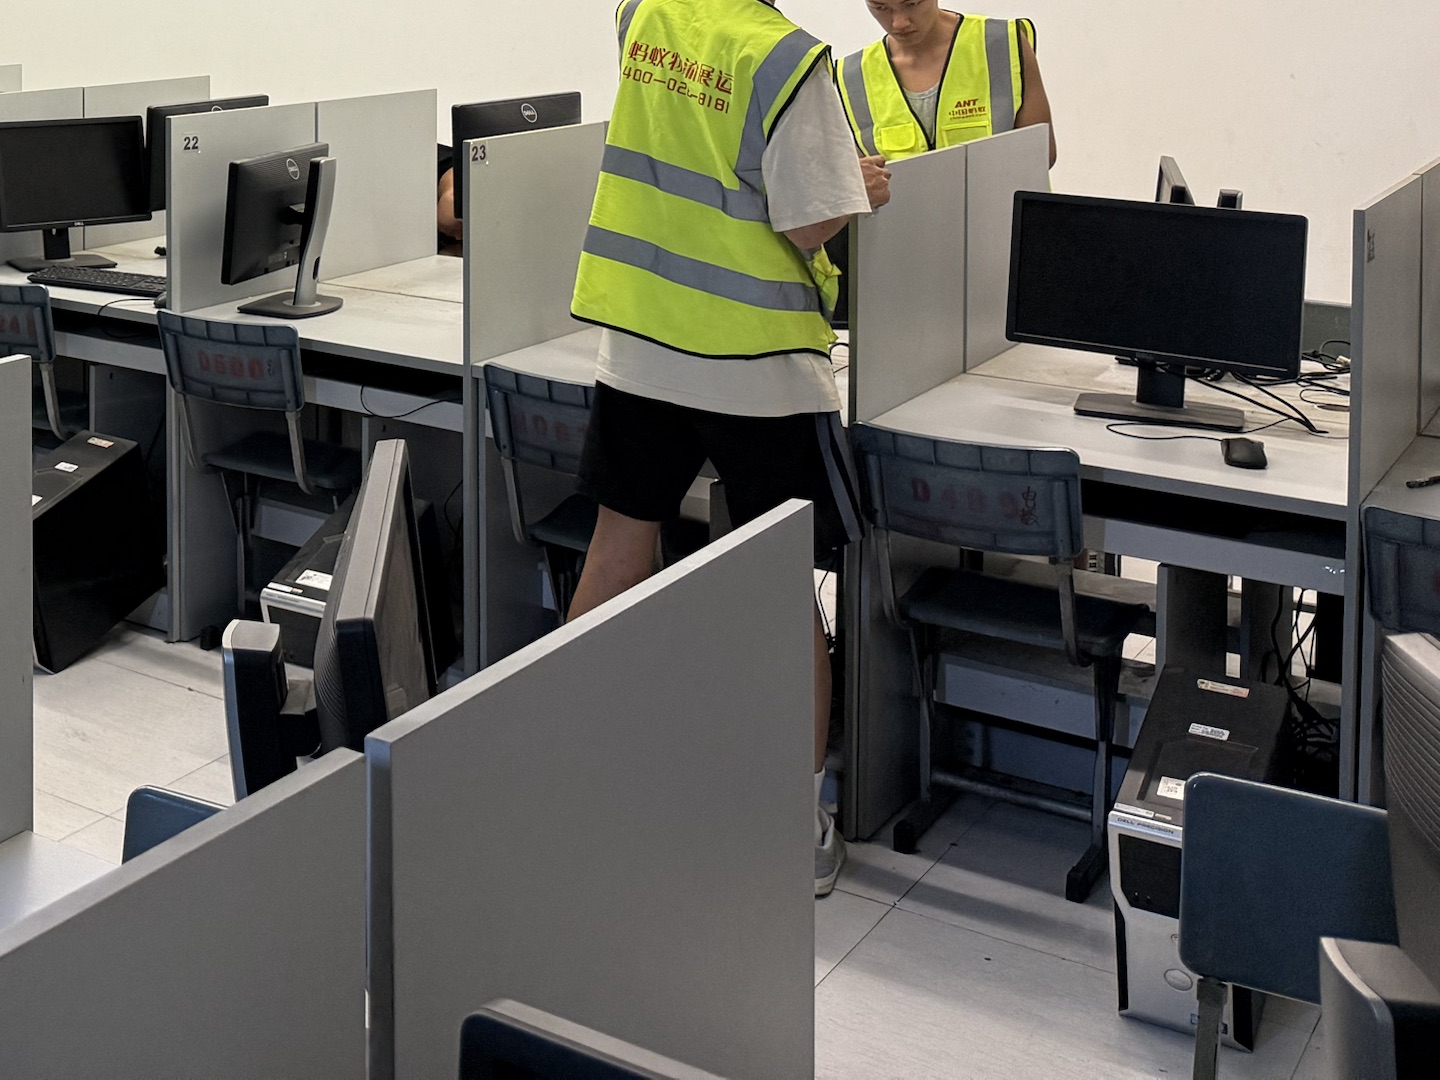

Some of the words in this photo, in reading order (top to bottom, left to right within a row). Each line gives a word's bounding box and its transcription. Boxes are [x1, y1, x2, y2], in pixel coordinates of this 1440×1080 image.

[954, 98, 978, 108] ANT
[183, 136, 199, 151] 22
[471, 145, 486, 162] 23
